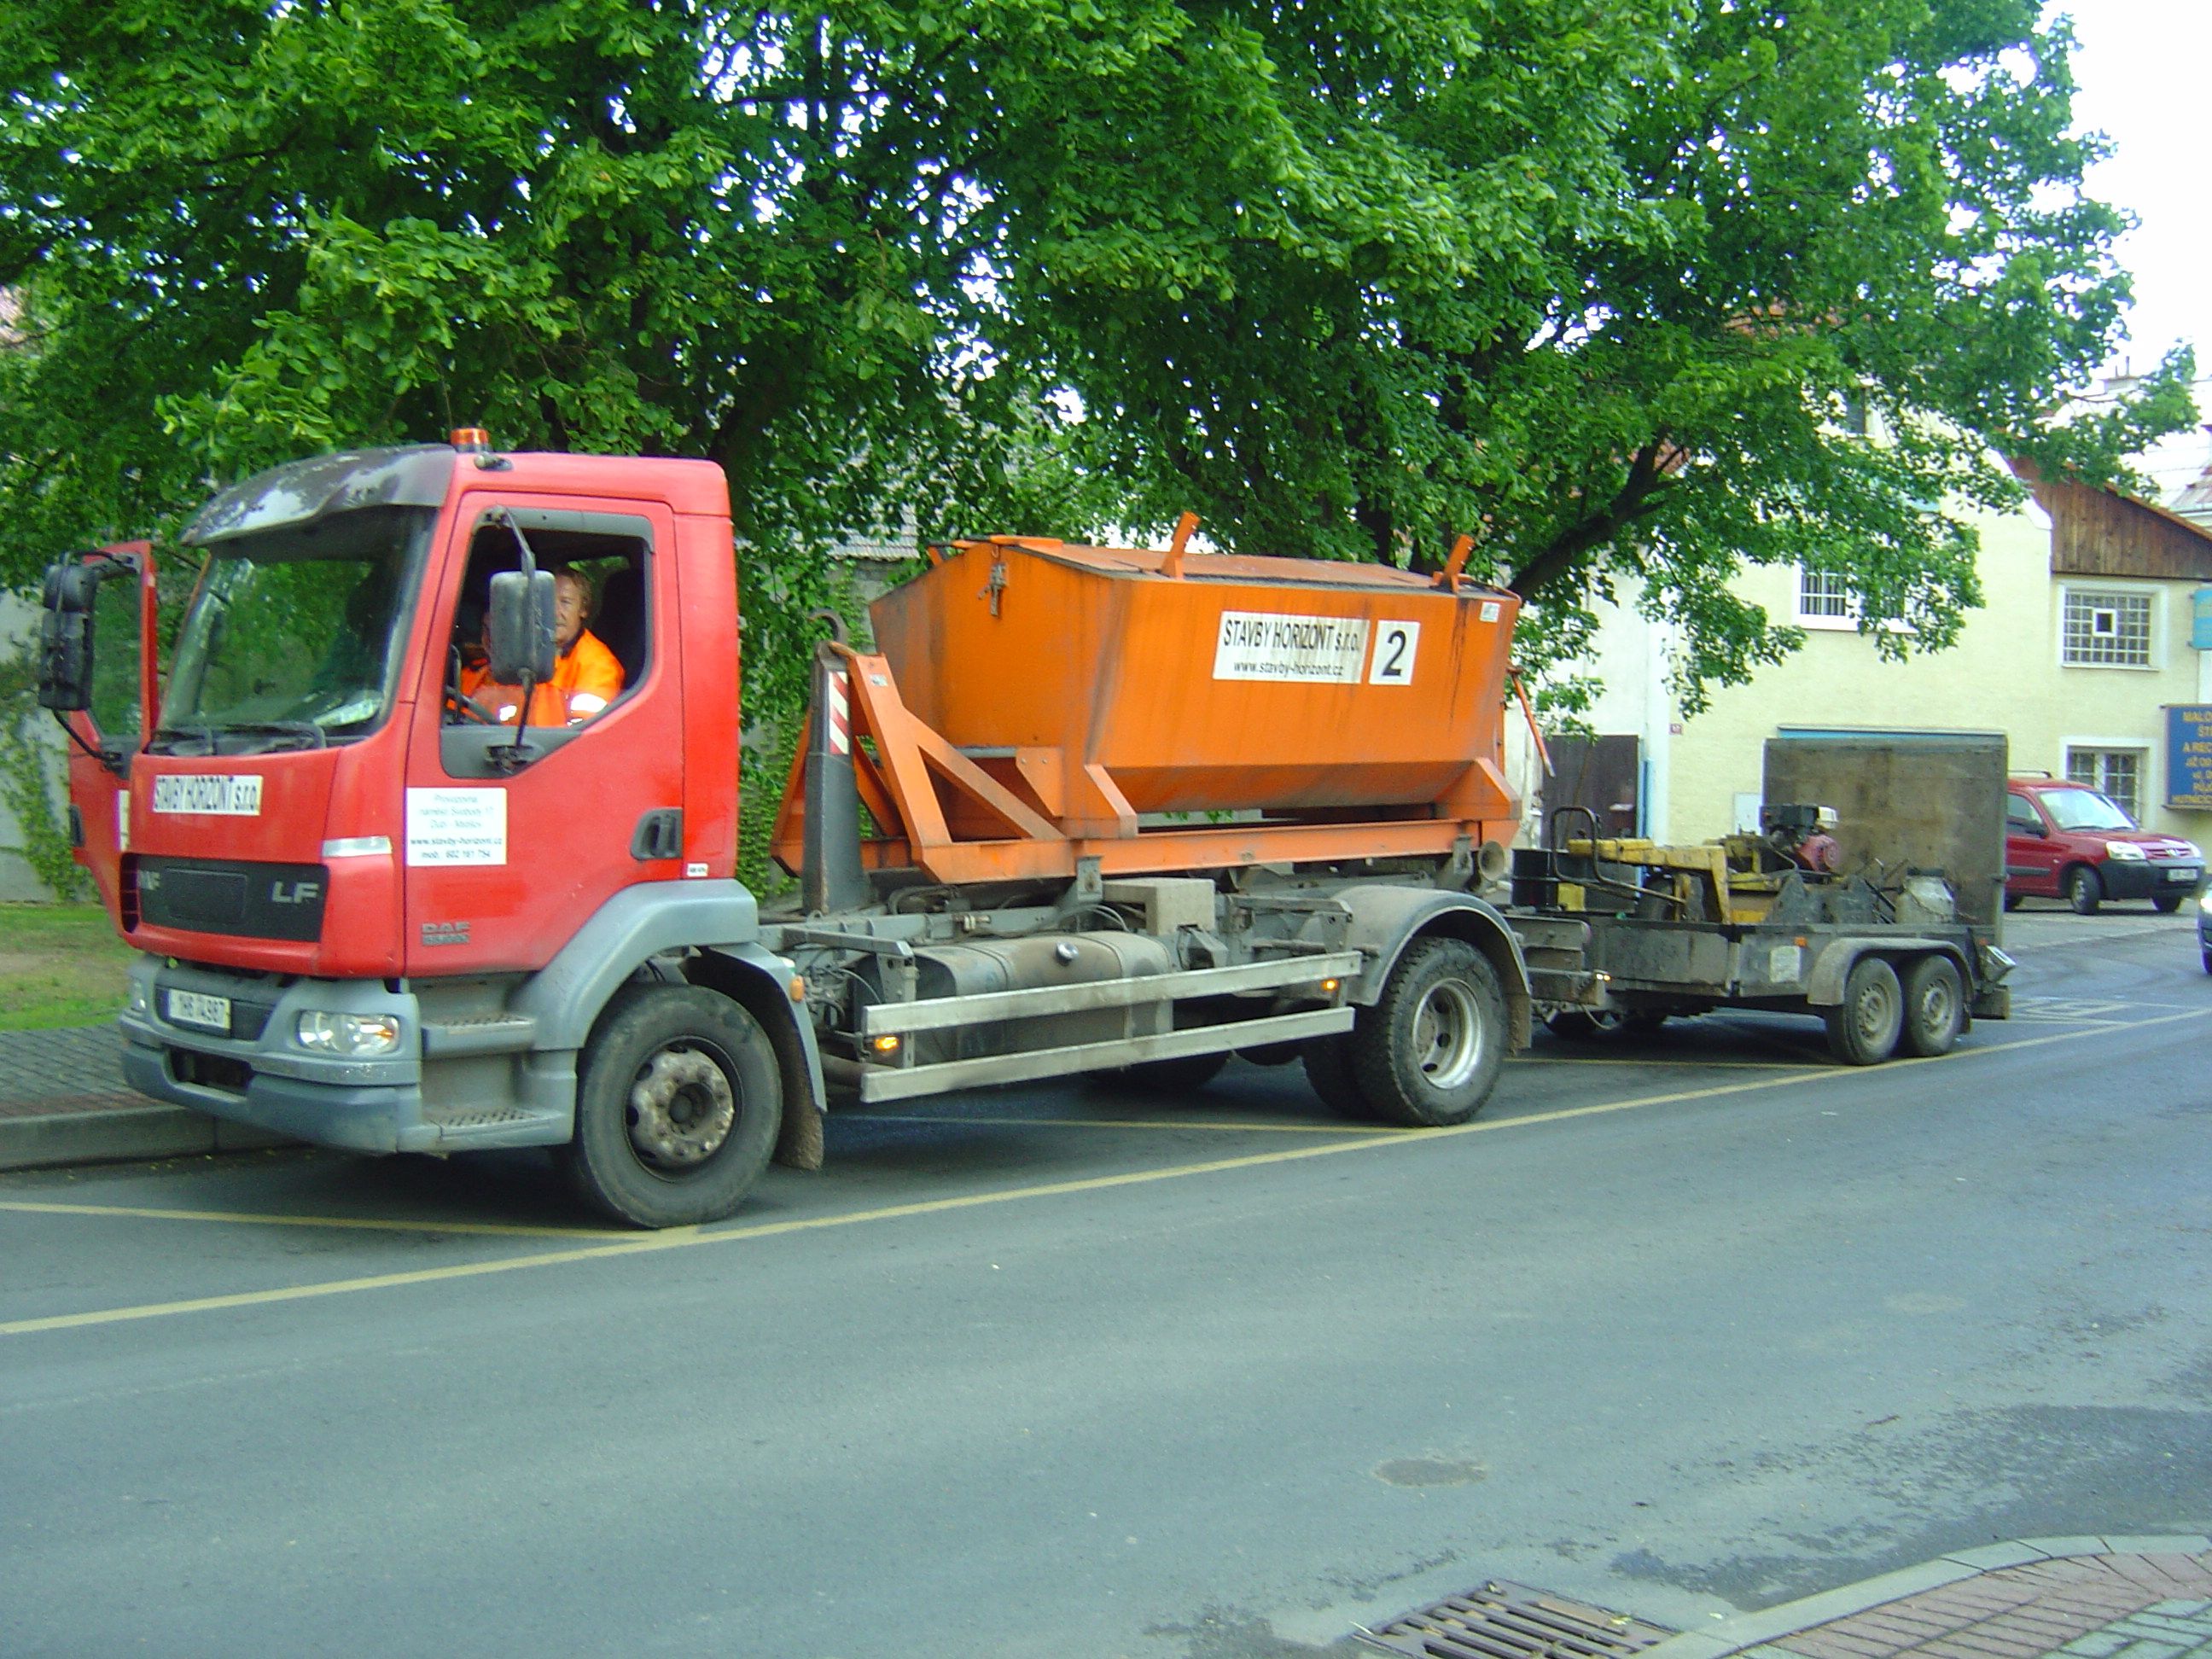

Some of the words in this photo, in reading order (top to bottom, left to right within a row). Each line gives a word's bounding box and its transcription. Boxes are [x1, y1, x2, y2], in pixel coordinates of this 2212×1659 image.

[1224, 620, 1272, 648] STAVBY
[1272, 621, 1334, 649] HORIZONT
[1335, 632, 1359, 652] s.r.o.
[1382, 629, 1407, 678] 2
[1234, 661, 1344, 678] www.stavby-horizont.cz
[155, 775, 184, 811] STAVBY
[185, 775, 234, 811] HORIZONT
[410, 837, 504, 847] www.stavby-horizont.cz
[271, 880, 319, 904] LF
[422, 922, 471, 933] DAF
